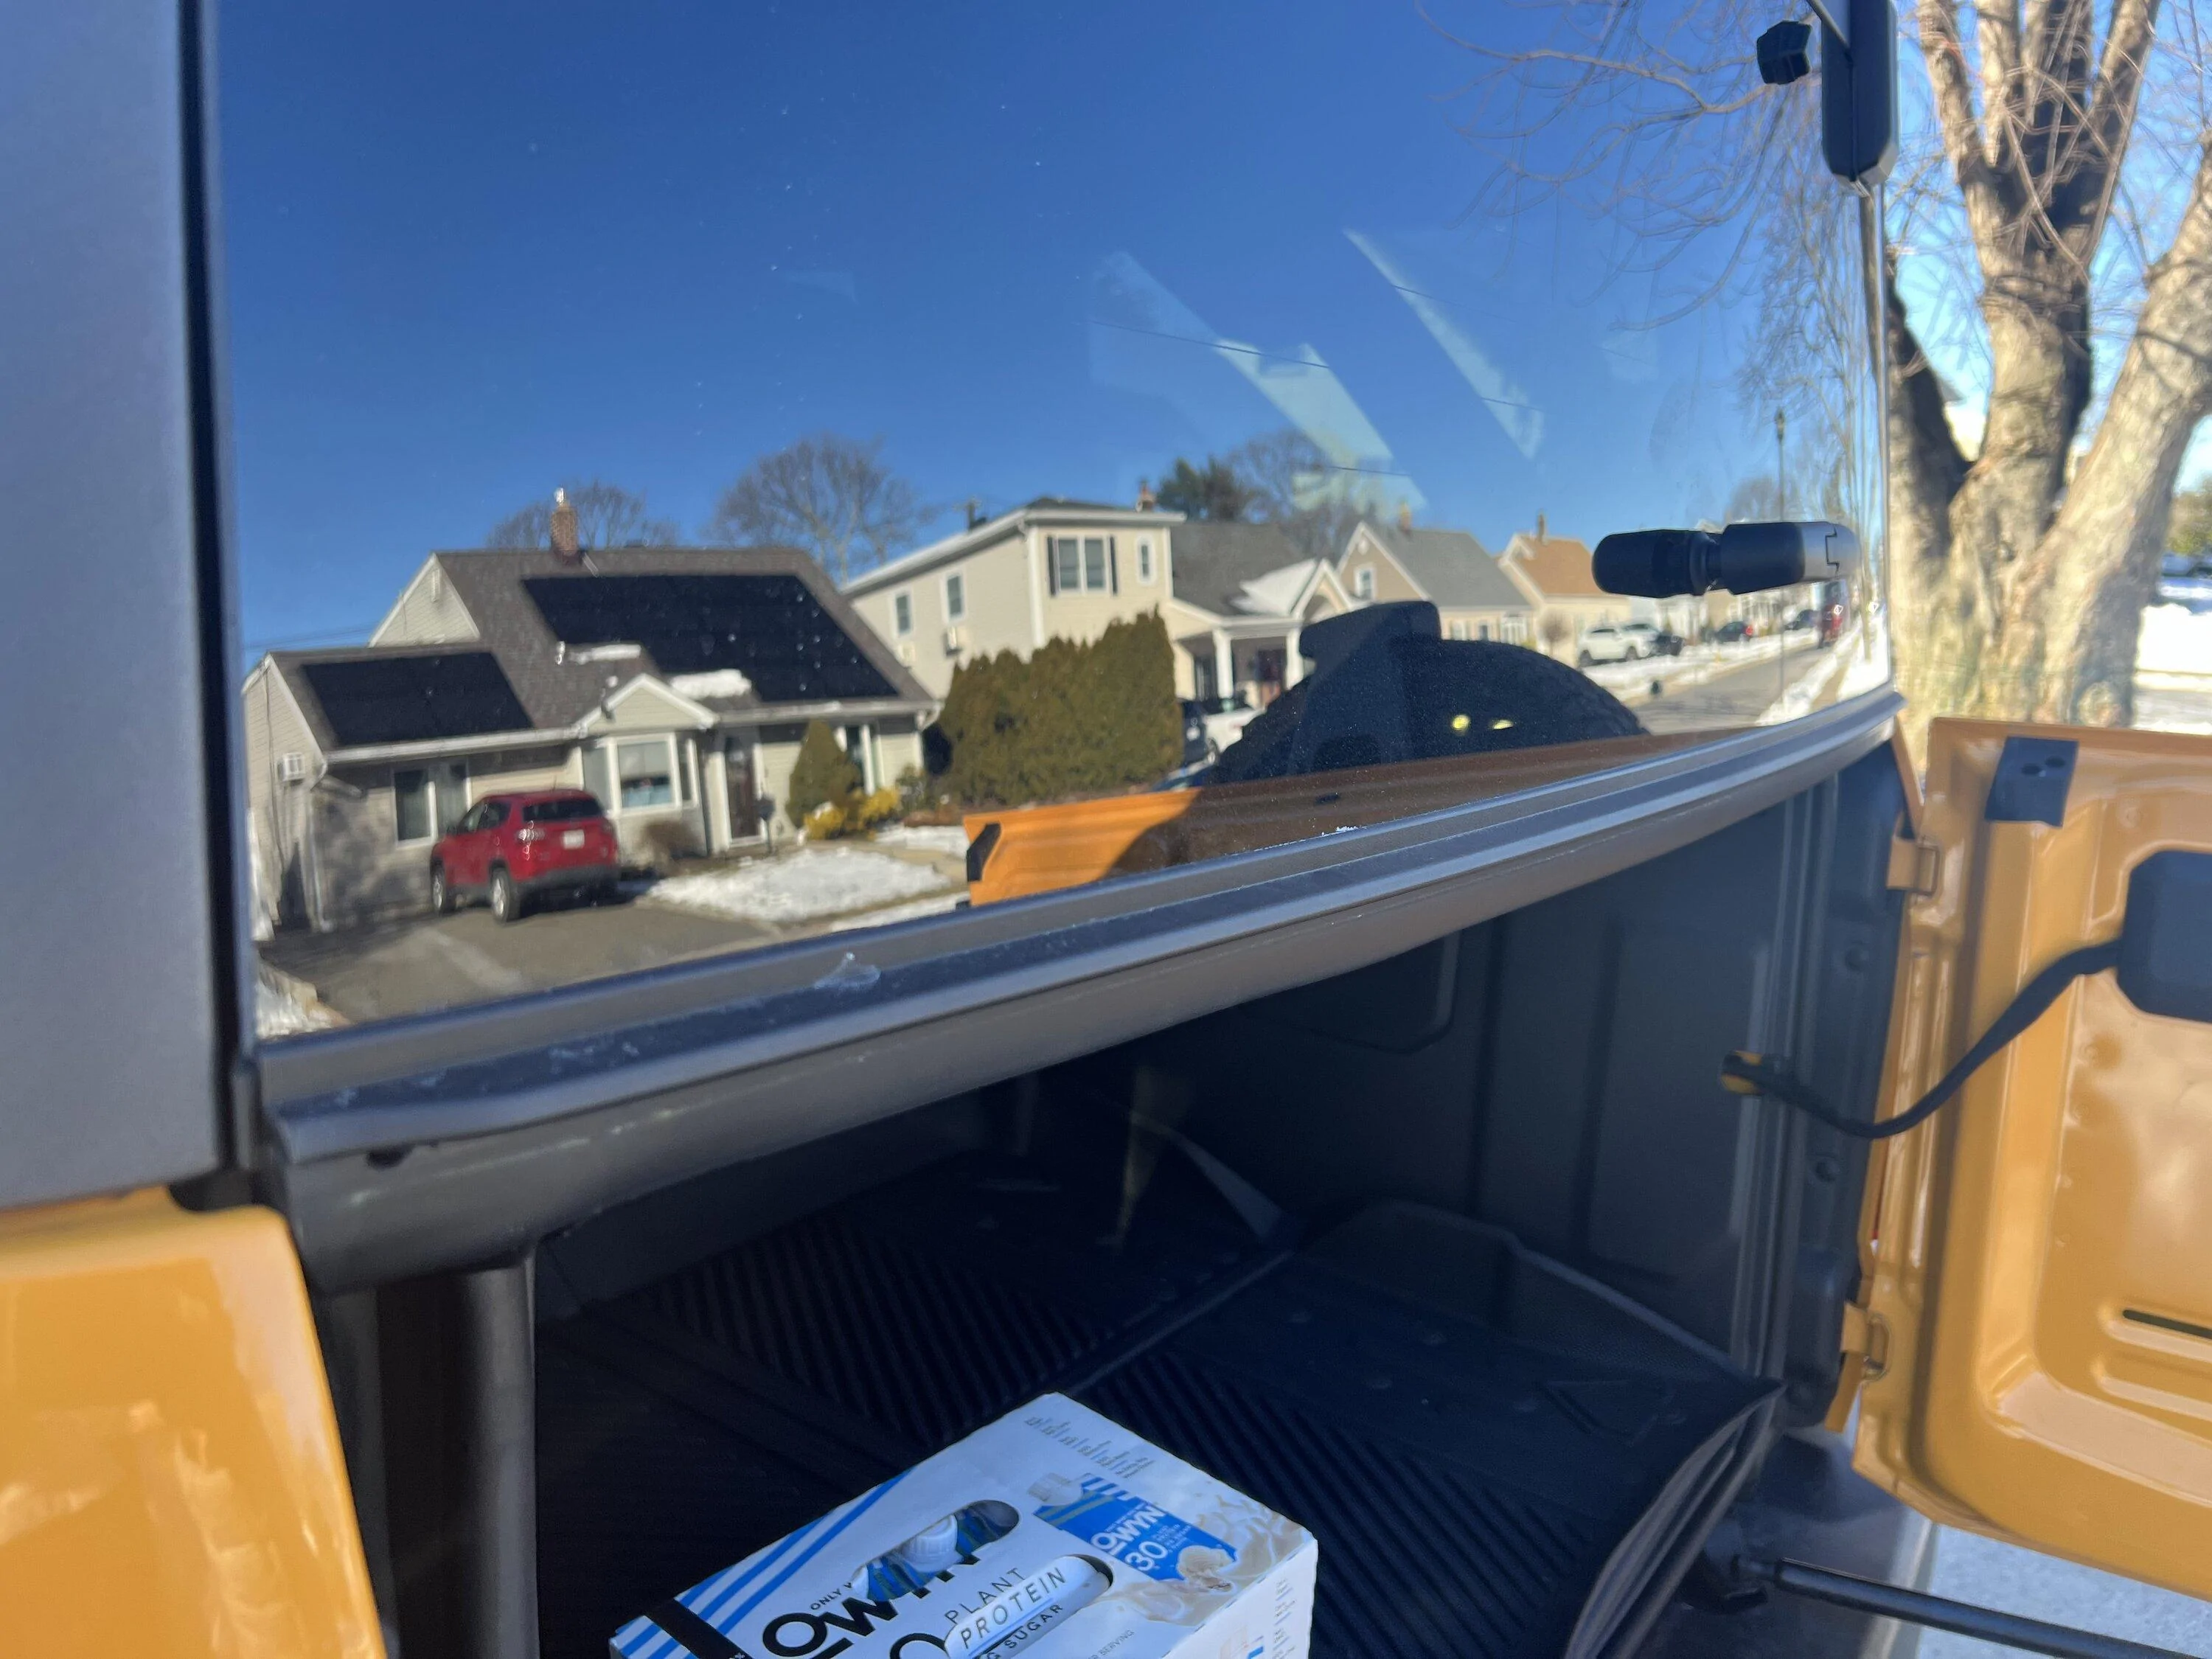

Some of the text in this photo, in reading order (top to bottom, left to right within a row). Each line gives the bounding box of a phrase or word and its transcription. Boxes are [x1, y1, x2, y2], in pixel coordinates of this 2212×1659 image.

[1091, 1505, 1166, 1552] OWYN
[1124, 1541, 1169, 1571] 30
[810, 1588, 842, 1610] ONLY
[944, 1568, 1027, 1624] PLANT
[959, 1568, 1067, 1649] PROTEIN
[1004, 1604, 1063, 1649] SUGAR
